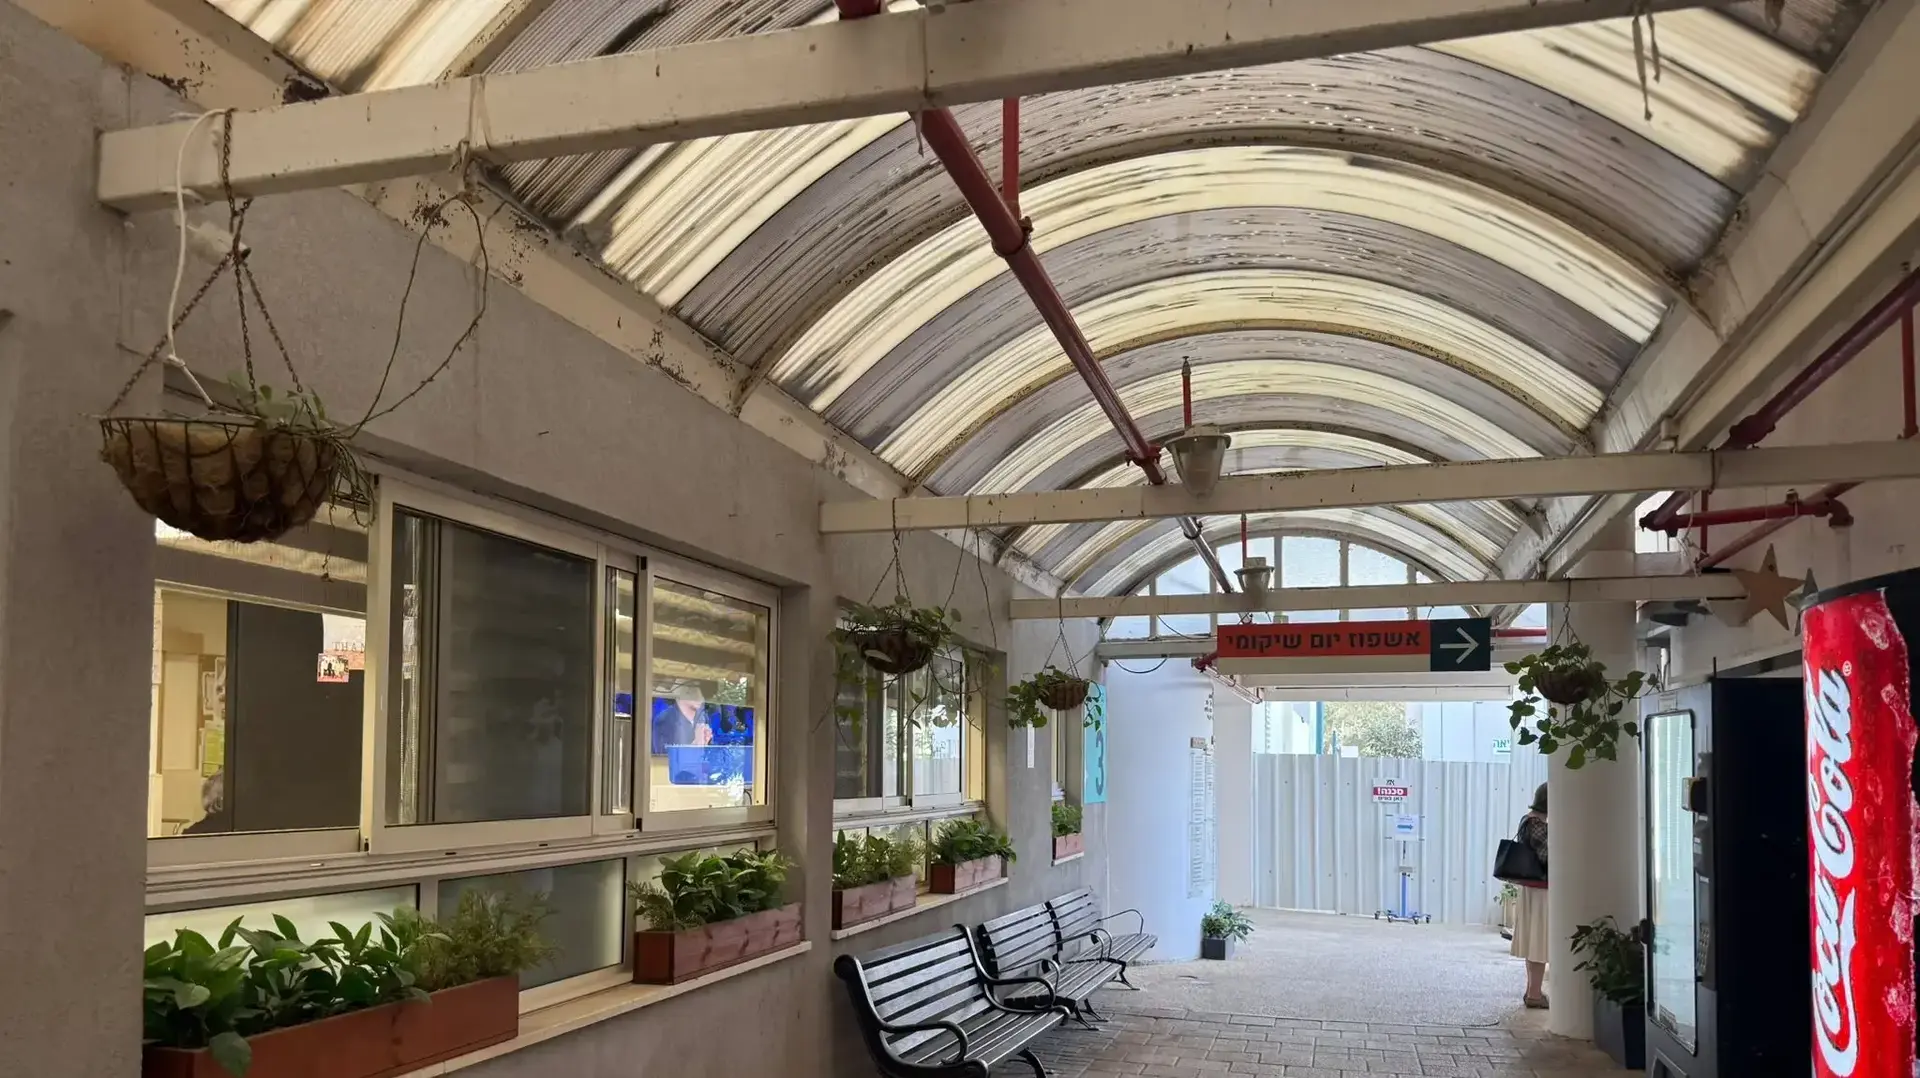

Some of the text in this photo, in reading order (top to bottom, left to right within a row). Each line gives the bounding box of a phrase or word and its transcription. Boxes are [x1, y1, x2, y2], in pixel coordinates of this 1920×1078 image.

[331, 641, 365, 654] THAN
[1226, 631, 1421, 653] אשפוז יום שיקומי
[1492, 739, 1511, 748] יאה
[1095, 730, 1105, 796] 3
[1377, 787, 1404, 795] סכנה!
